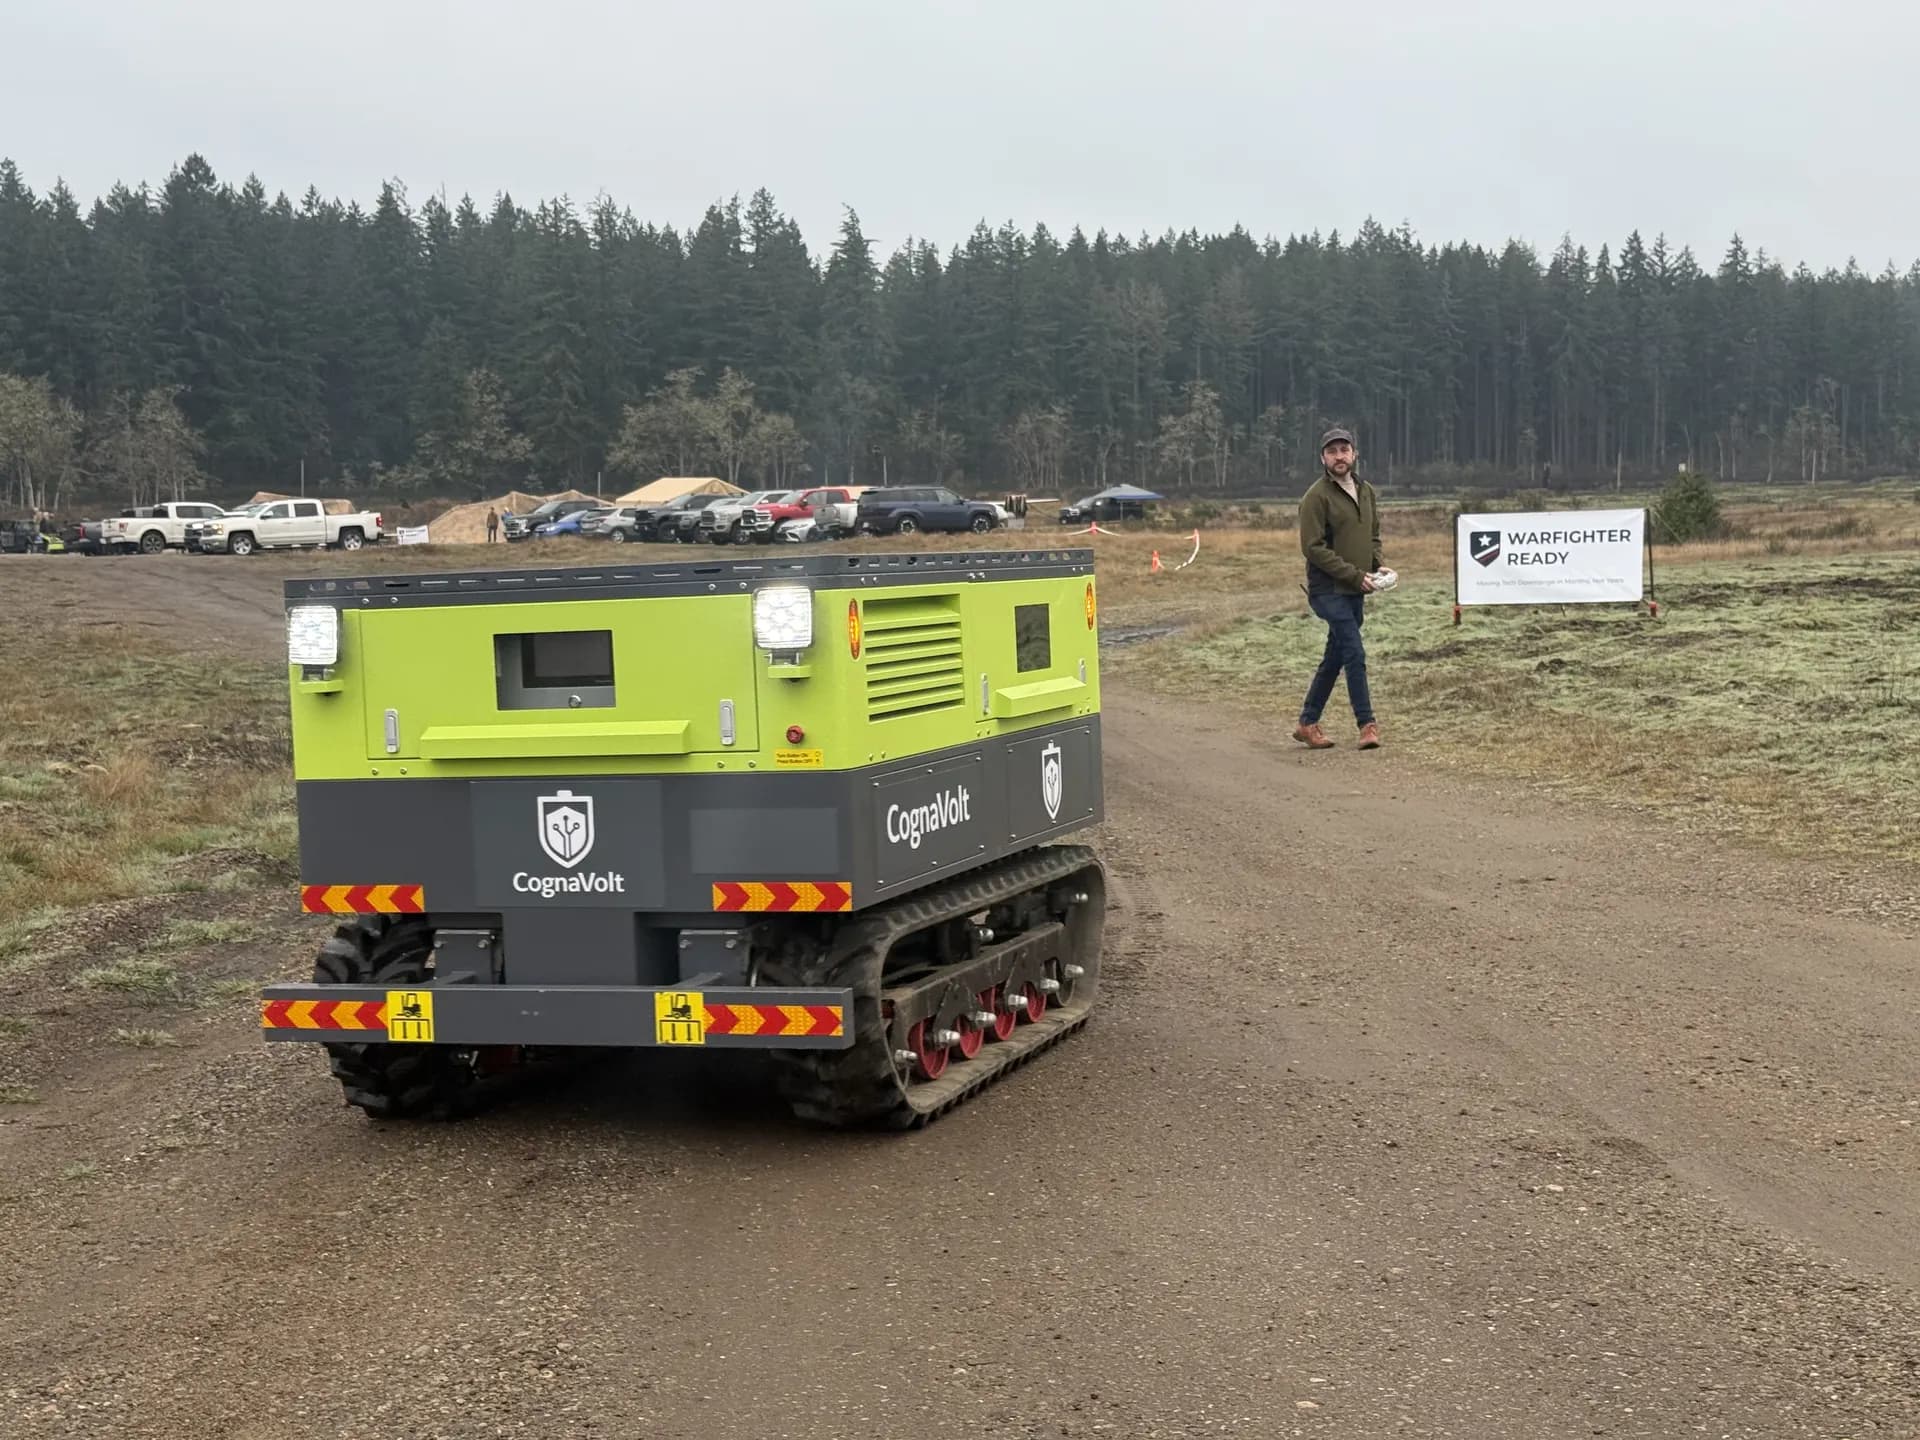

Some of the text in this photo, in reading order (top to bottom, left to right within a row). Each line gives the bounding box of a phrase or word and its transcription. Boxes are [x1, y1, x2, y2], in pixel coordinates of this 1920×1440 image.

[1507, 529, 1631, 545] WARFIGHTER
[1507, 551, 1569, 566] READY
[887, 784, 970, 849] CognaVolt
[512, 871, 625, 898] CognaVolt
